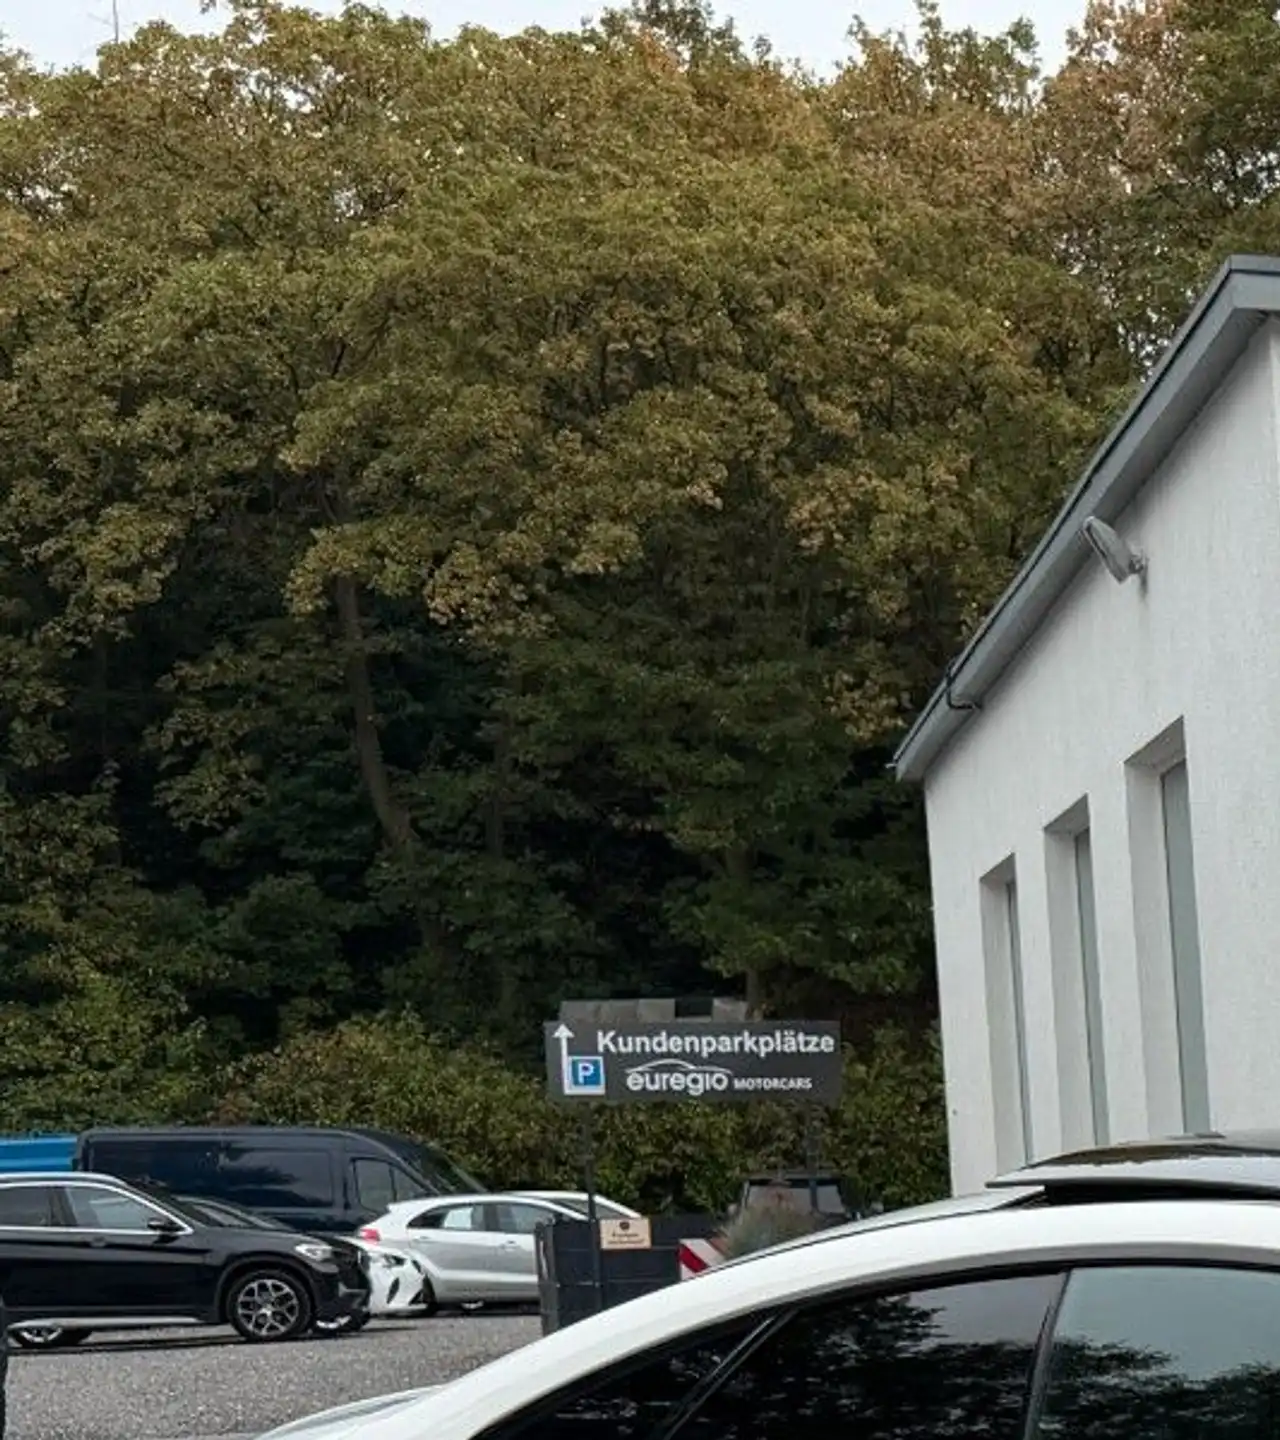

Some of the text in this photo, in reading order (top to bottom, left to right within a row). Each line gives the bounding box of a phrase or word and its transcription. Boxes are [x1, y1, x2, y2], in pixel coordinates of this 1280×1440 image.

[597, 1029, 835, 1058] Kundenparkplätze
[577, 1062, 595, 1085] P
[626, 1071, 813, 1097] euregio MOTORCARS
